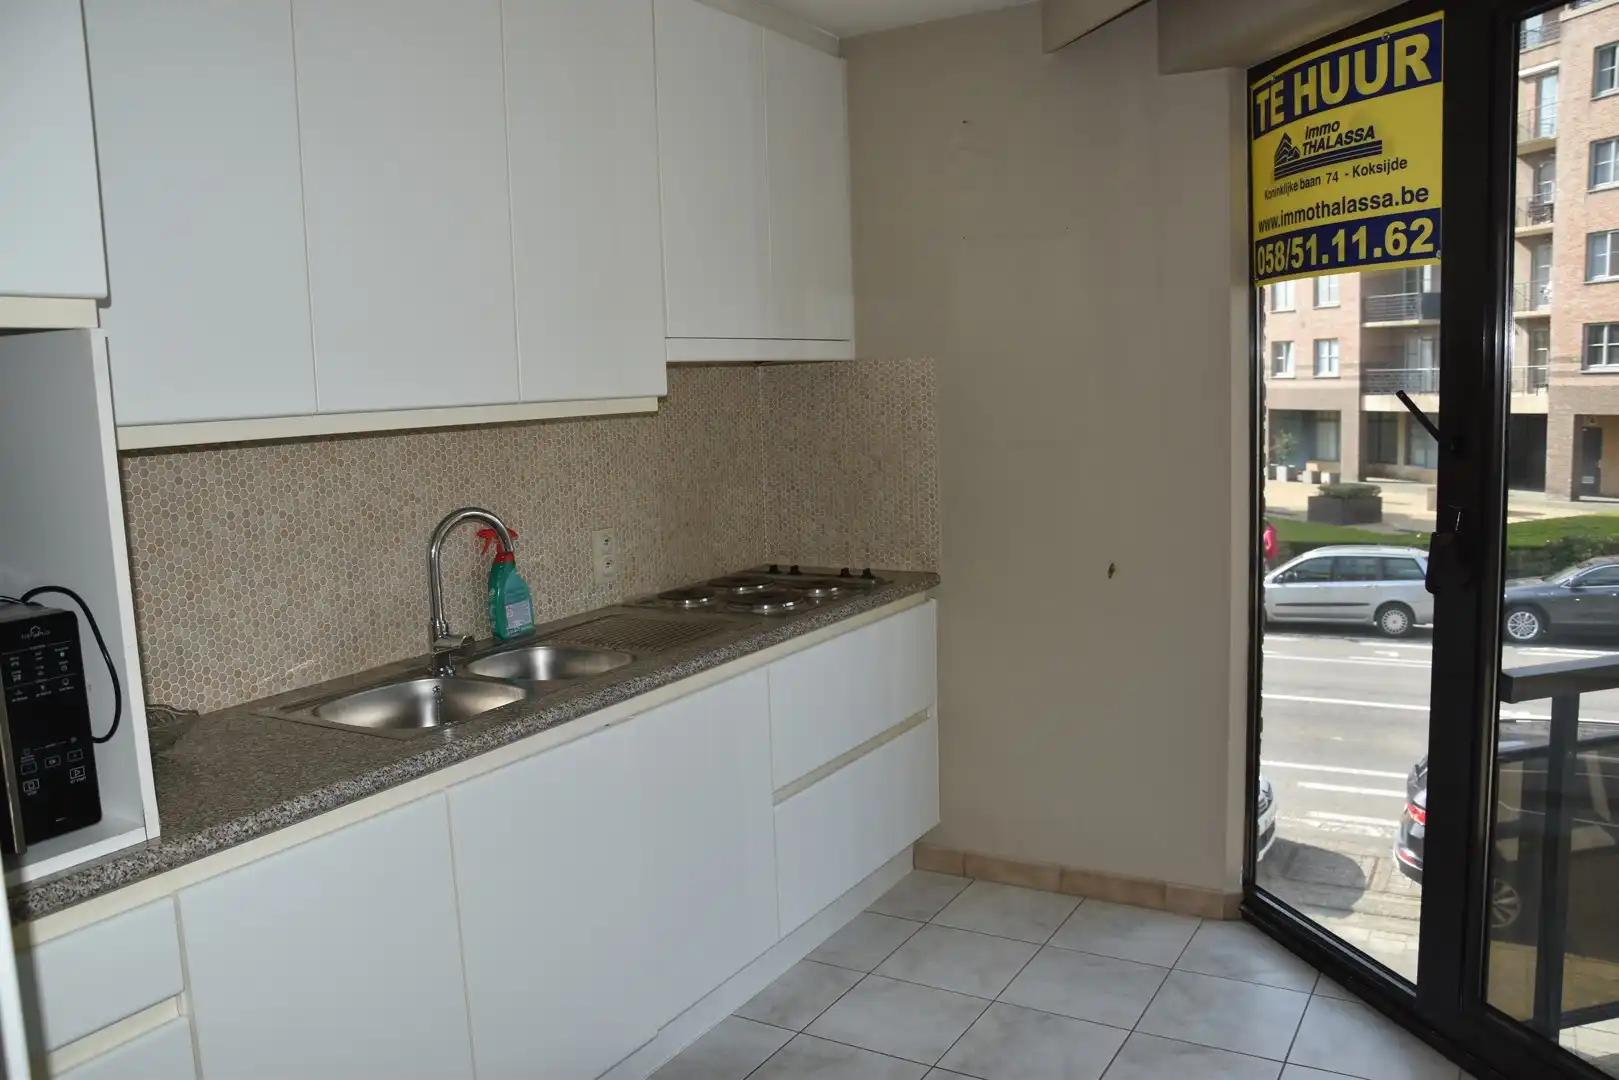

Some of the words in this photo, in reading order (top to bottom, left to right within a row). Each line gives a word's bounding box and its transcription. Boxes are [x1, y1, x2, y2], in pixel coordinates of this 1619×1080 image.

[1256, 80, 1285, 132] TE
[1294, 33, 1432, 117] HUUR
[1303, 125, 1375, 155] THALASSA
[1300, 176, 1321, 190] baan
[1326, 170, 1339, 184] 74
[1352, 157, 1408, 178] Koksijde
[1258, 186, 1429, 233] www.immothalassa.be
[1257, 217, 1434, 276] 058/51.11.62
